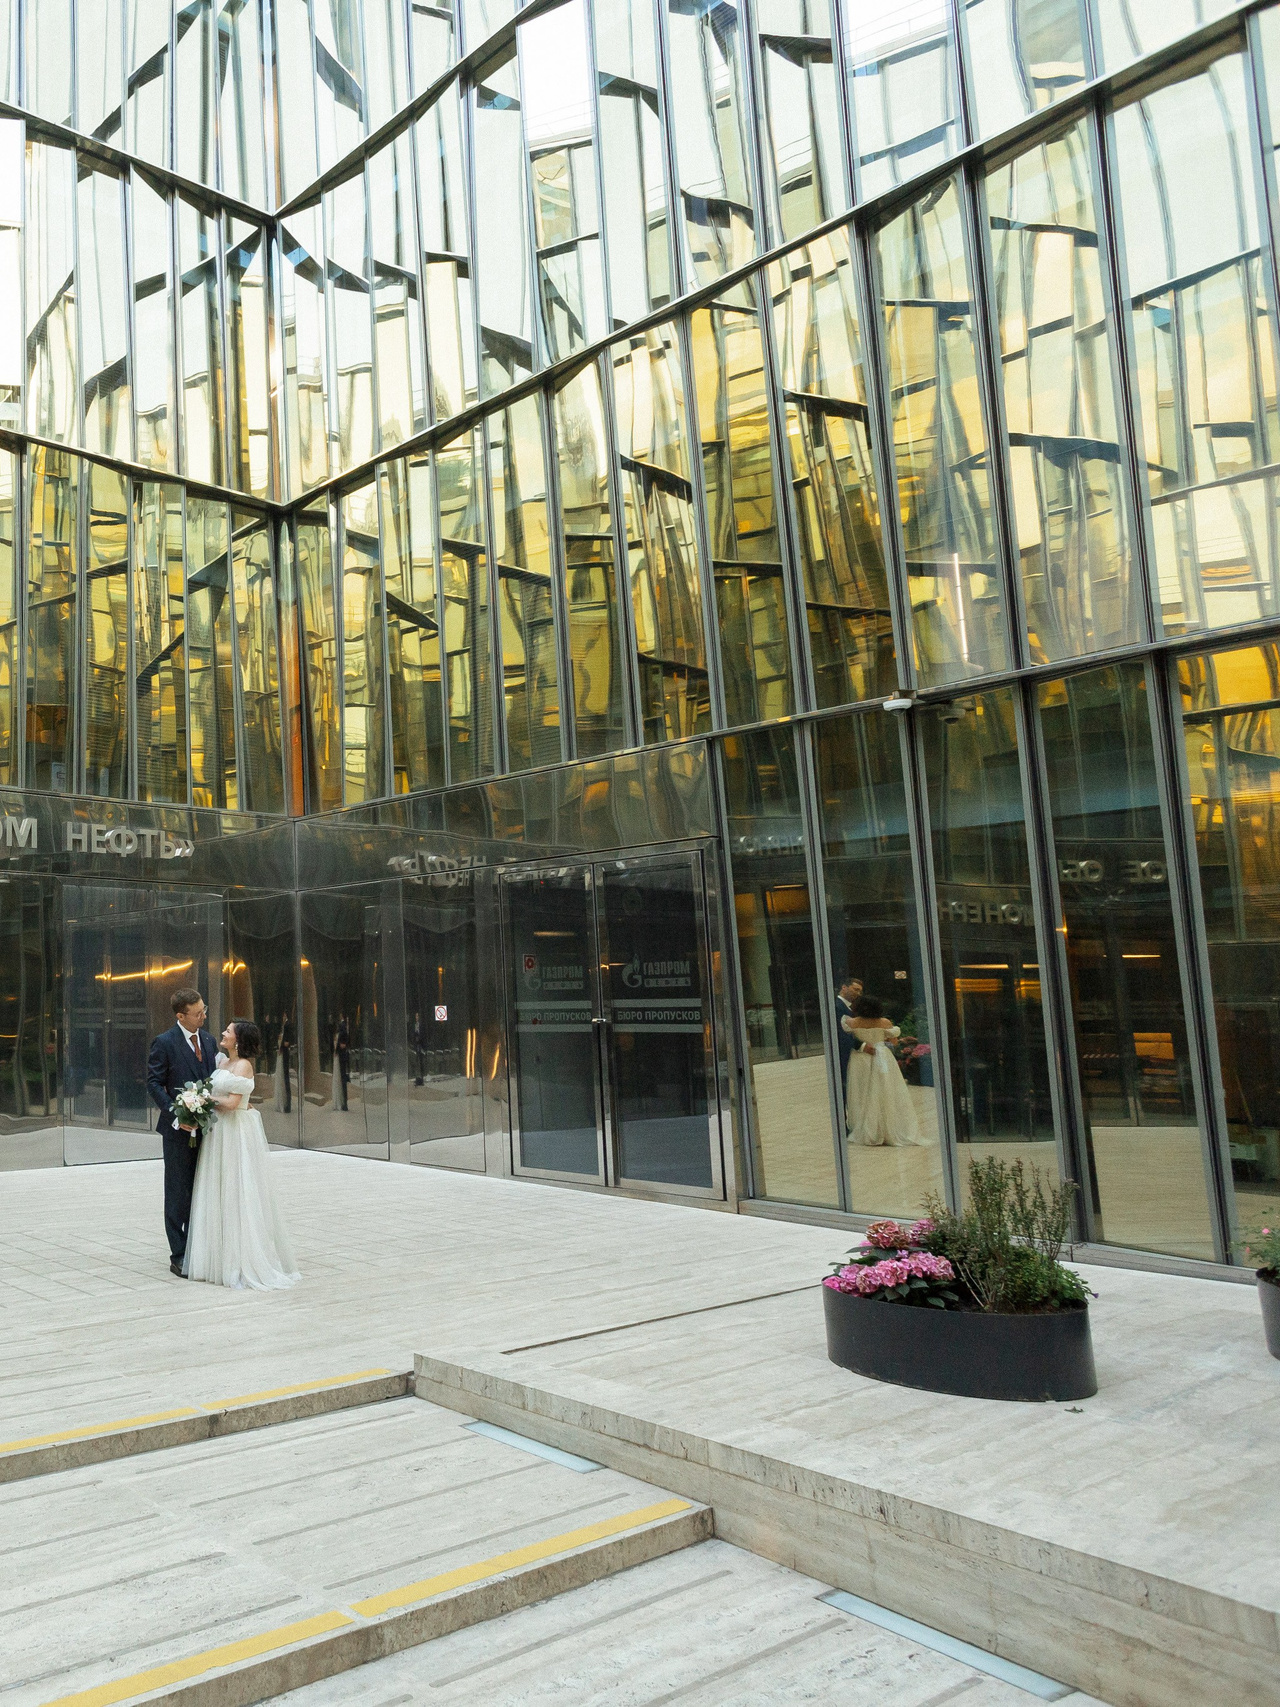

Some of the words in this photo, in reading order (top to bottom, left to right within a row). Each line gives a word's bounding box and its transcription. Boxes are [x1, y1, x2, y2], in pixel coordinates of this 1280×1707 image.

[65, 820, 197, 860] НЕФТЬ»
[541, 965, 584, 979] ГАЗПРОМ
[643, 960, 691, 976] ГАЗПРОМ
[544, 1011, 592, 1021] ПРОПУСКОВ
[617, 1011, 643, 1021] БЮРО
[645, 1010, 701, 1021] ПРОПУСКОВ
